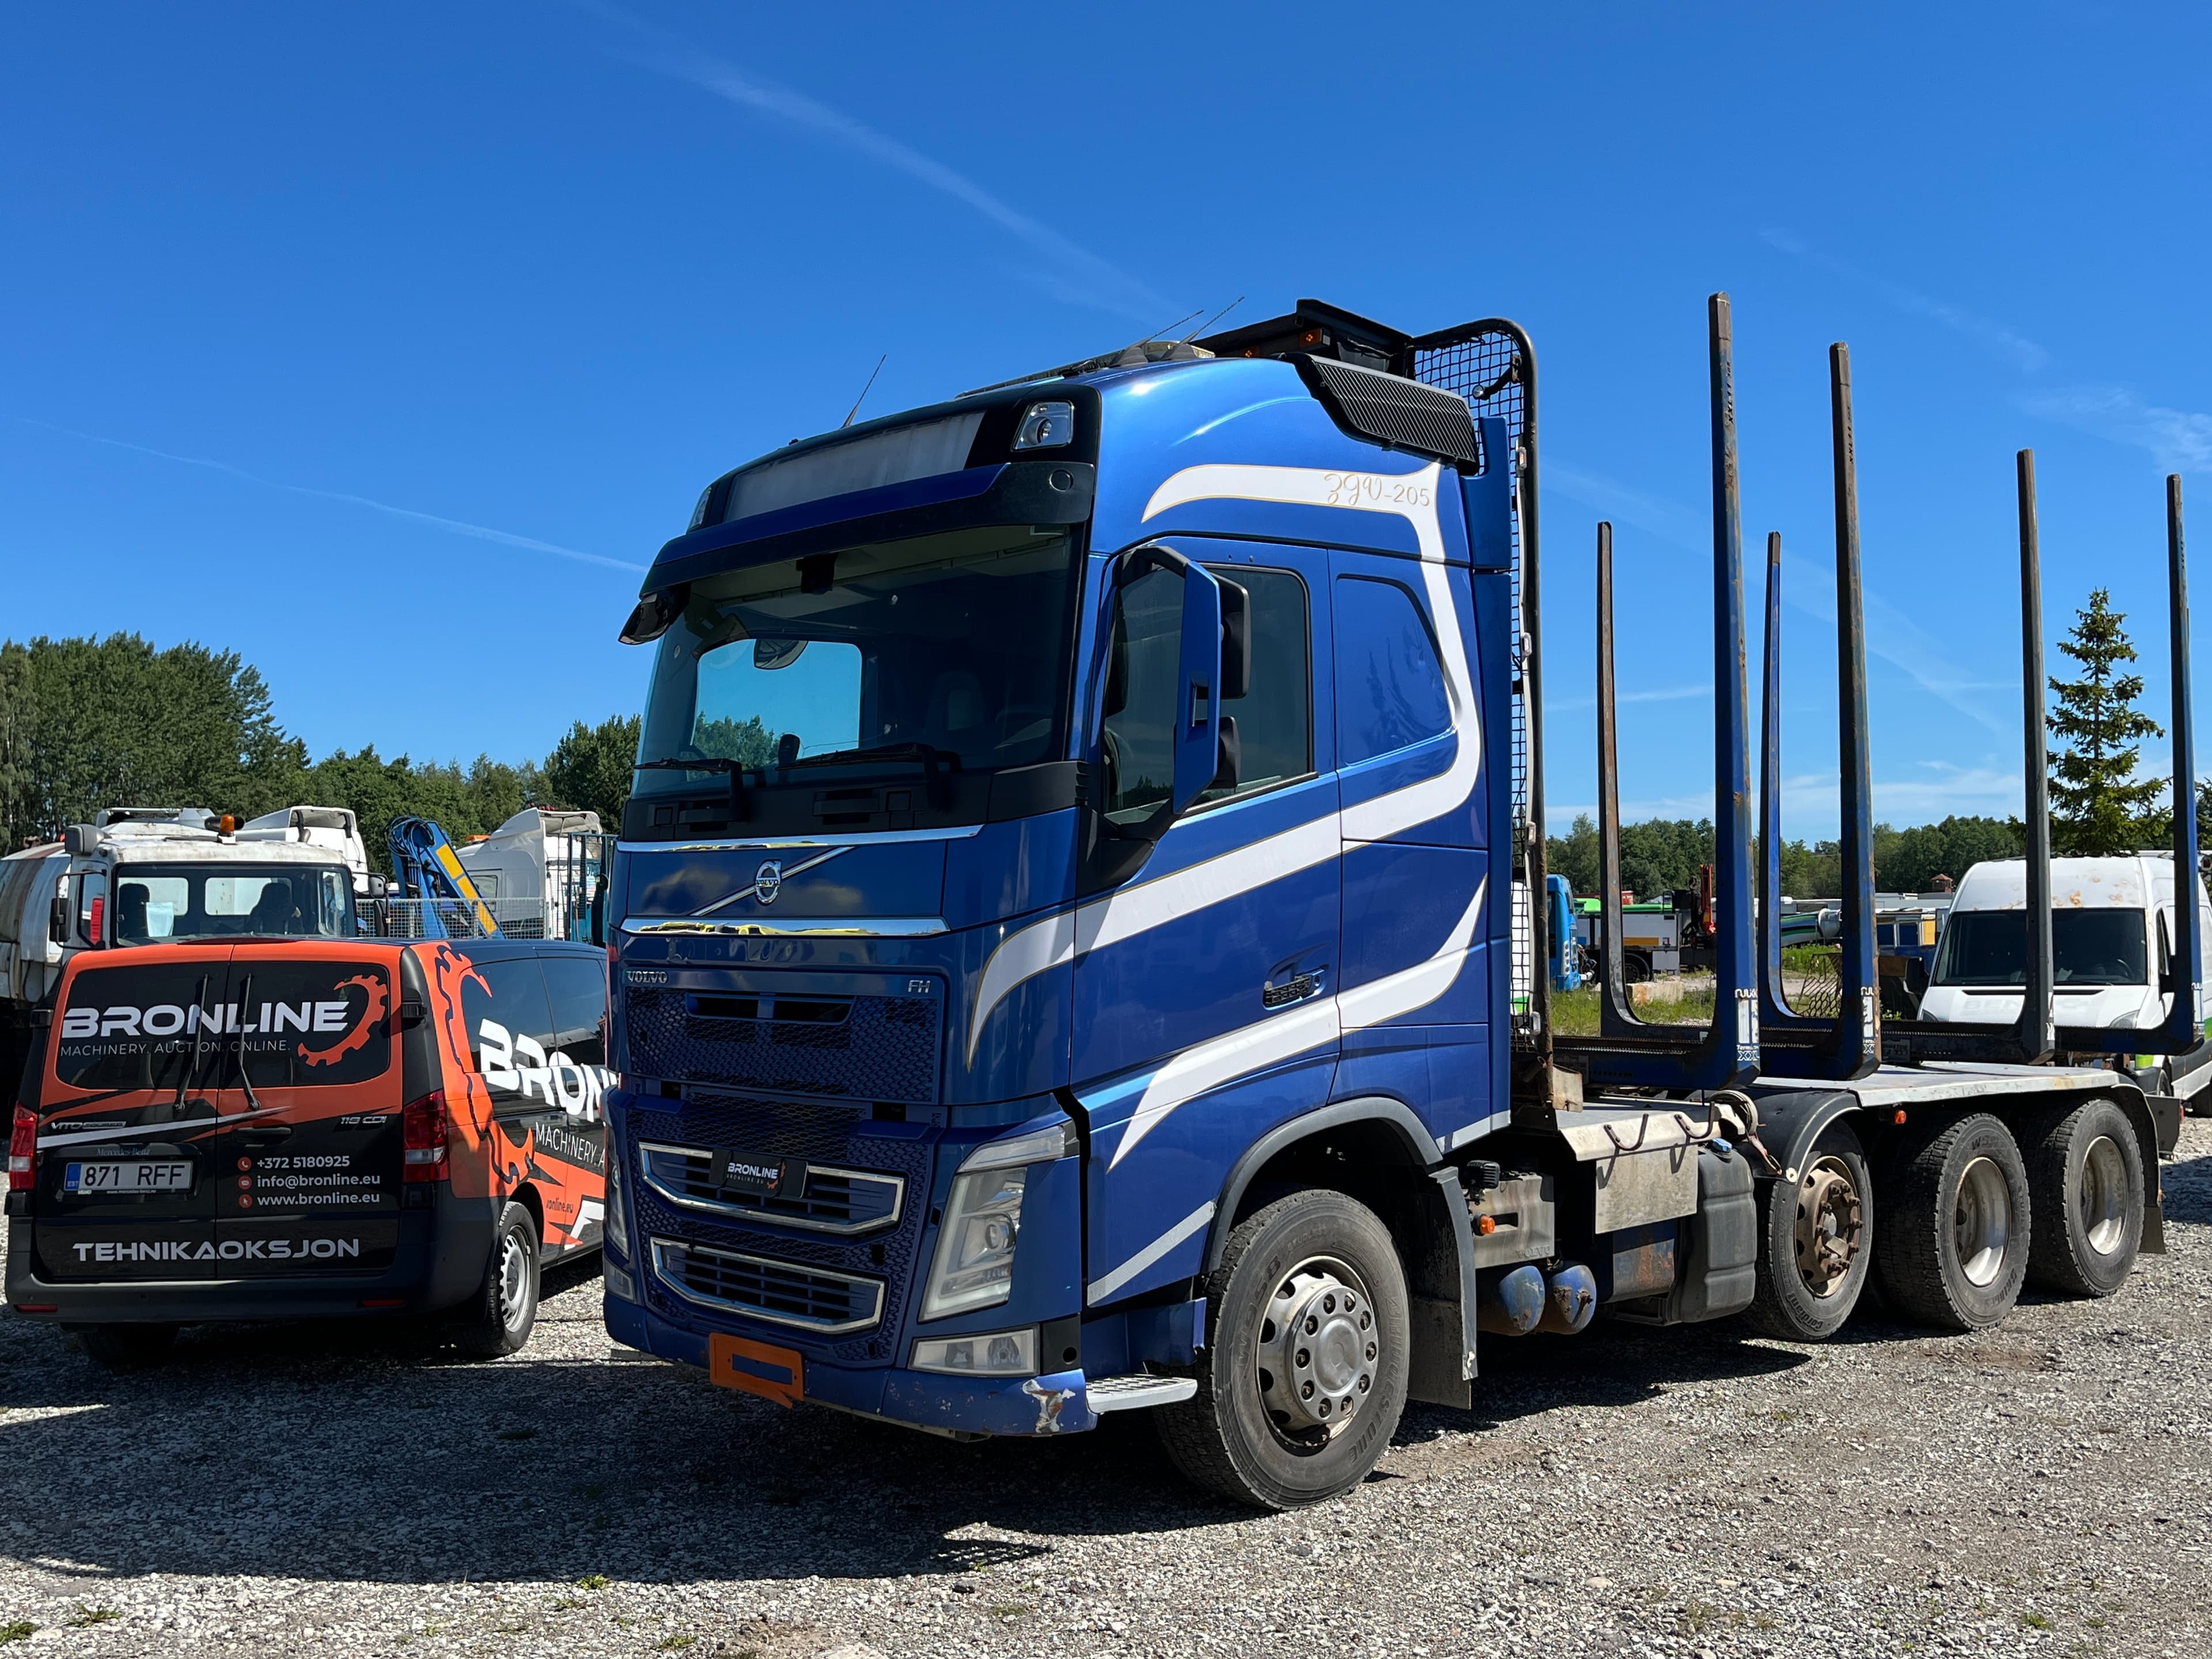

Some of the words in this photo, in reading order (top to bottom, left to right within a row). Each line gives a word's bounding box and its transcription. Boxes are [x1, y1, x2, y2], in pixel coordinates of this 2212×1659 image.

[627, 971, 668, 983] VOLVO
[908, 980, 930, 993] FH
[62, 1001, 350, 1038] BRONLINE
[60, 1043, 149, 1056] MACHINERY.
[154, 1041, 224, 1054] AUCTON.
[479, 1018, 617, 1123] BRON
[51, 1122, 83, 1130] VITO
[257, 1157, 289, 1169] +372
[293, 1156, 350, 1168] 5180925
[85, 1166, 120, 1187] 871
[137, 1165, 185, 1185] RFF
[728, 1162, 779, 1180] BRONLINE
[257, 1173, 380, 1189] info@bronline.eu
[257, 1192, 380, 1206] www.bronline.eu
[72, 1238, 359, 1262] TEHNIKAOKSJON
